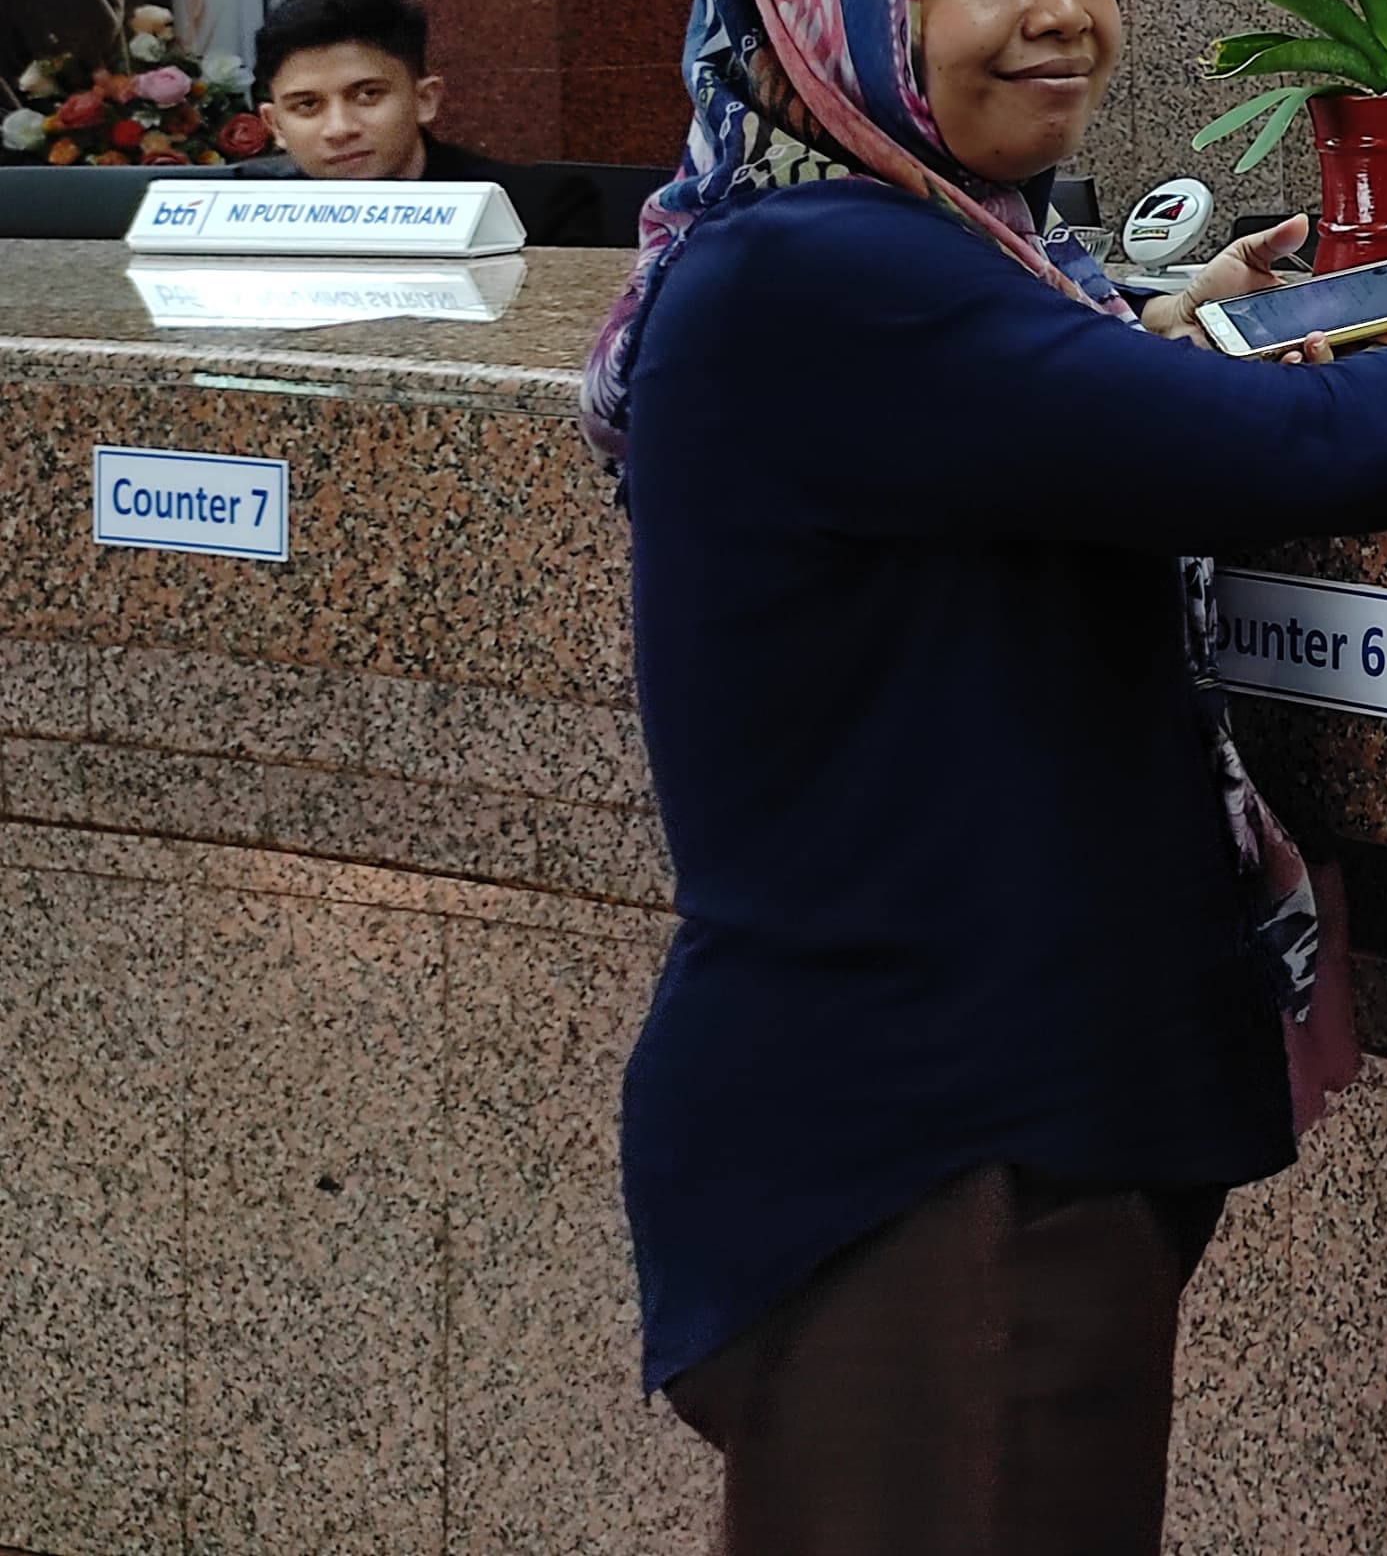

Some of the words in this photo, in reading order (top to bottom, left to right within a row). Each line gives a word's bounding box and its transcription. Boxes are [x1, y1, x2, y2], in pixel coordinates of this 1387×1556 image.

[152, 199, 204, 227] btn
[226, 203, 248, 223] NI
[248, 203, 304, 224] PUTU
[304, 203, 362, 225] NINDI
[362, 204, 457, 226] SATRIANI
[112, 477, 241, 525] Counter
[251, 489, 269, 527] 7
[1216, 617, 1348, 670] ounter
[1361, 626, 1386, 678] 6
